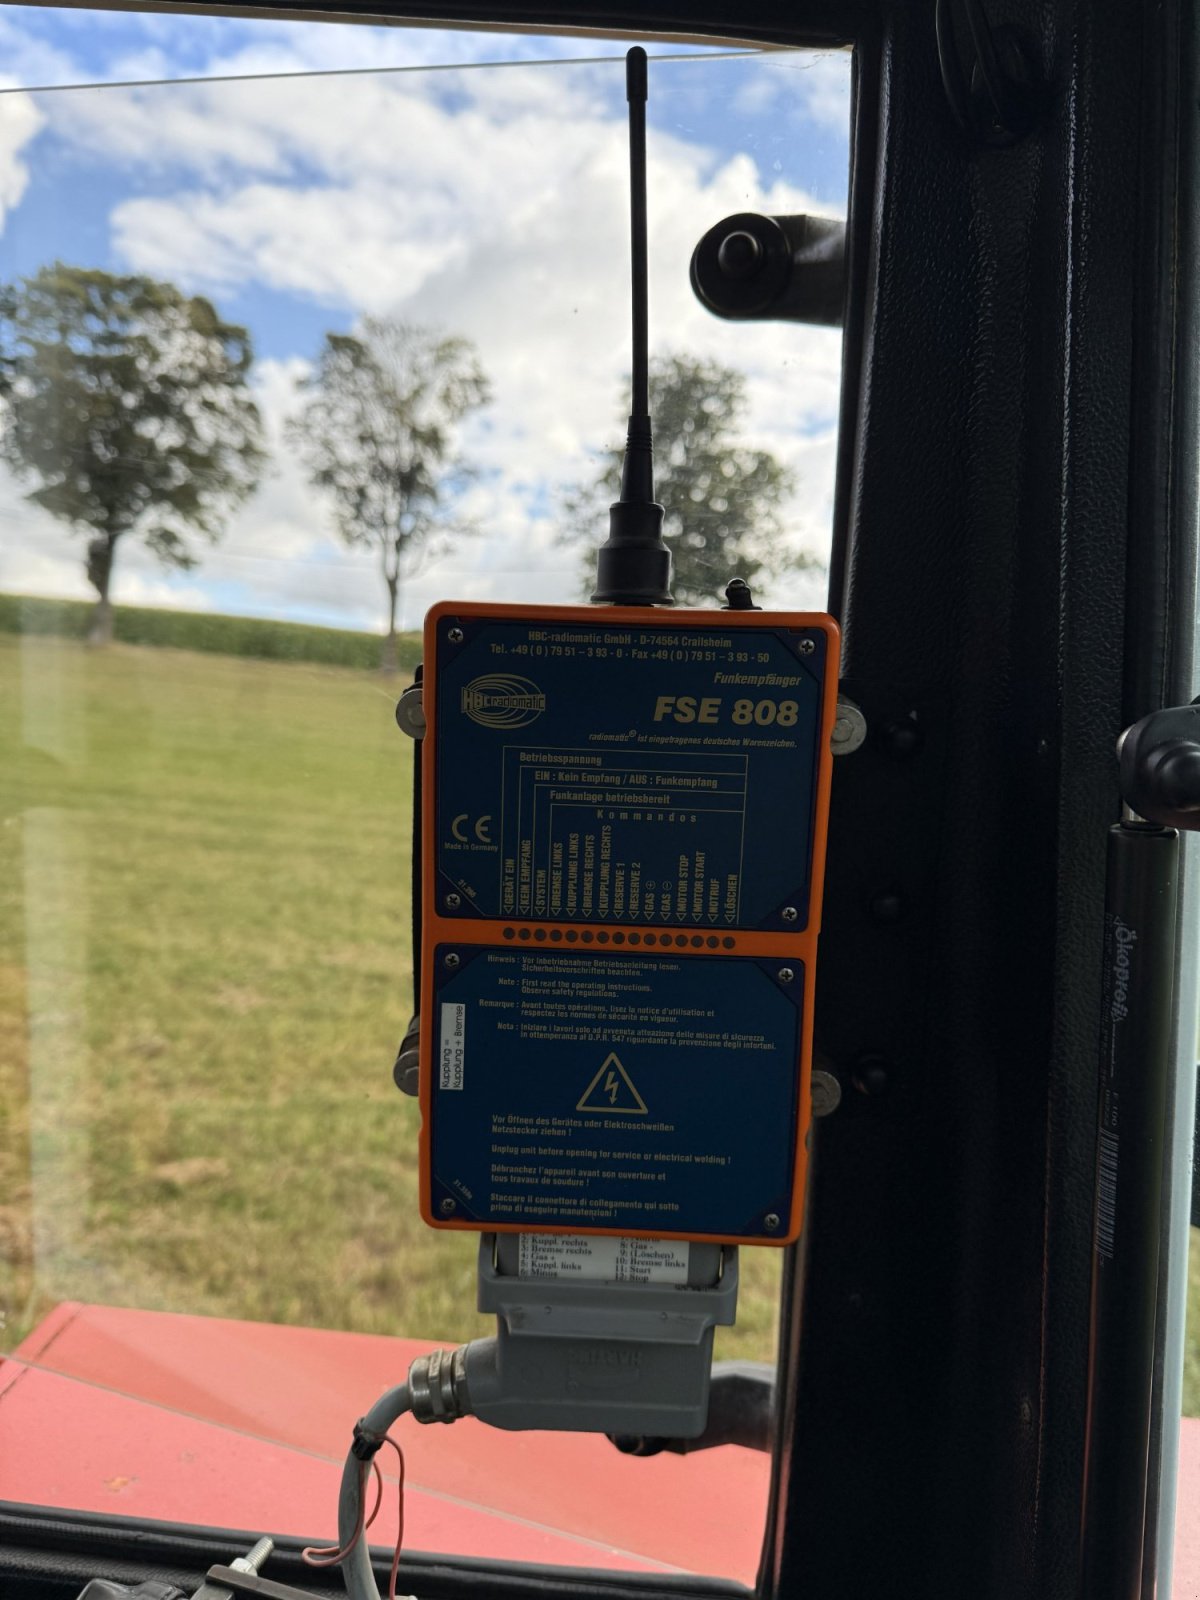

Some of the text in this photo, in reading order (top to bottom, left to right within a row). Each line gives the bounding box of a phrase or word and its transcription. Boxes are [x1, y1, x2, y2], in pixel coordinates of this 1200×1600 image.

[528, 631, 731, 647] HBC-radiomatic GmbH D-74564 Crailsheim
[490, 644, 508, 654] Tel.
[510, 644, 528, 655] +49
[631, 648, 648, 659] Fax
[650, 649, 668, 659] +49
[714, 672, 801, 688] Funkempfänger
[653, 696, 799, 727] FSE 808
[638, 734, 648, 743] ist
[648, 735, 702, 746] eingetragenes
[703, 736, 741, 746] deutsches
[519, 752, 602, 767] Betriebsspannung
[535, 771, 718, 789] EIN Kein Empfang AUS Funkempfang
[550, 791, 671, 804] Funkanlage betriebsbereit
[452, 814, 492, 843] CE
[444, 842, 499, 853] Made Germany
[520, 839, 531, 906] KEIN EMPFANG
[551, 842, 563, 907] BREMSE LINKS
[567, 833, 580, 908] KUPPLUNG LINKS
[582, 835, 595, 908] BREMSE RECHTS
[598, 825, 612, 909] KUPPLUNG RECHTS
[503, 859, 515, 905] GERÄT EIN
[535, 870, 546, 906] SYSTEM
[614, 871, 625, 909] RESERVE
[677, 855, 689, 912] MOTOR STOP
[693, 850, 705, 913] MOTOR START
[630, 872, 641, 910] RESERVE
[708, 878, 720, 913] NOTRUF
[724, 874, 738, 914] LÖSCHEN
[644, 893, 656, 911] GAS
[661, 893, 672, 911] GAS
[487, 955, 516, 963] Hinweis
[522, 956, 535, 964] Vor
[536, 957, 592, 967] Inbetriebnahme
[593, 959, 657, 970] Betriebsanleitung
[498, 978, 515, 986] Note
[521, 979, 539, 987] First
[540, 980, 556, 988] read
[571, 981, 606, 991] operating
[608, 982, 652, 992] instructions.
[521, 987, 551, 995] Observe
[552, 989, 574, 997] safety
[479, 999, 515, 1008] Remarque
[637, 1006, 660, 1014] notice
[661, 1007, 705, 1016] d'utilisation
[521, 1010, 556, 1018] respectez
[497, 1022, 514, 1030] Nota
[730, 1033, 765, 1041] sicurezza
[453, 1006, 464, 1088] Kupplung Bremse
[626, 1035, 668, 1045] riguardante
[678, 1038, 722, 1047] prevenzione
[723, 1040, 742, 1048] degli
[442, 1048, 452, 1088] Kupplung
[492, 1115, 675, 1132] Vor Öffnen des Gerätes oder Elektroschweißen
[492, 1125, 567, 1136] Netzstecker ziehen
[491, 1145, 519, 1155] Unplug
[520, 1146, 537, 1154] unit
[538, 1146, 564, 1156] before
[565, 1148, 598, 1159] opening
[599, 1149, 611, 1158] for
[612, 1151, 643, 1160] service
[654, 1152, 693, 1162] electrical
[694, 1154, 726, 1166] welding
[491, 1164, 656, 1181] Débranchez l'appareil avant son ouverture
[491, 1174, 584, 1186] tous travaux soudure
[490, 1193, 679, 1210] Staccare connettore collegamento qui sotto
[490, 1203, 612, 1217] prima eseguire manutenzioni
[531, 1245, 592, 1255] Bremse rechts
[561, 1239, 588, 1247] rechts
[561, 1262, 582, 1270] links
[630, 1258, 663, 1266] Bremse
[630, 1266, 651, 1274] Start
[531, 1269, 558, 1277] Minus
[629, 1274, 649, 1282] Stop
